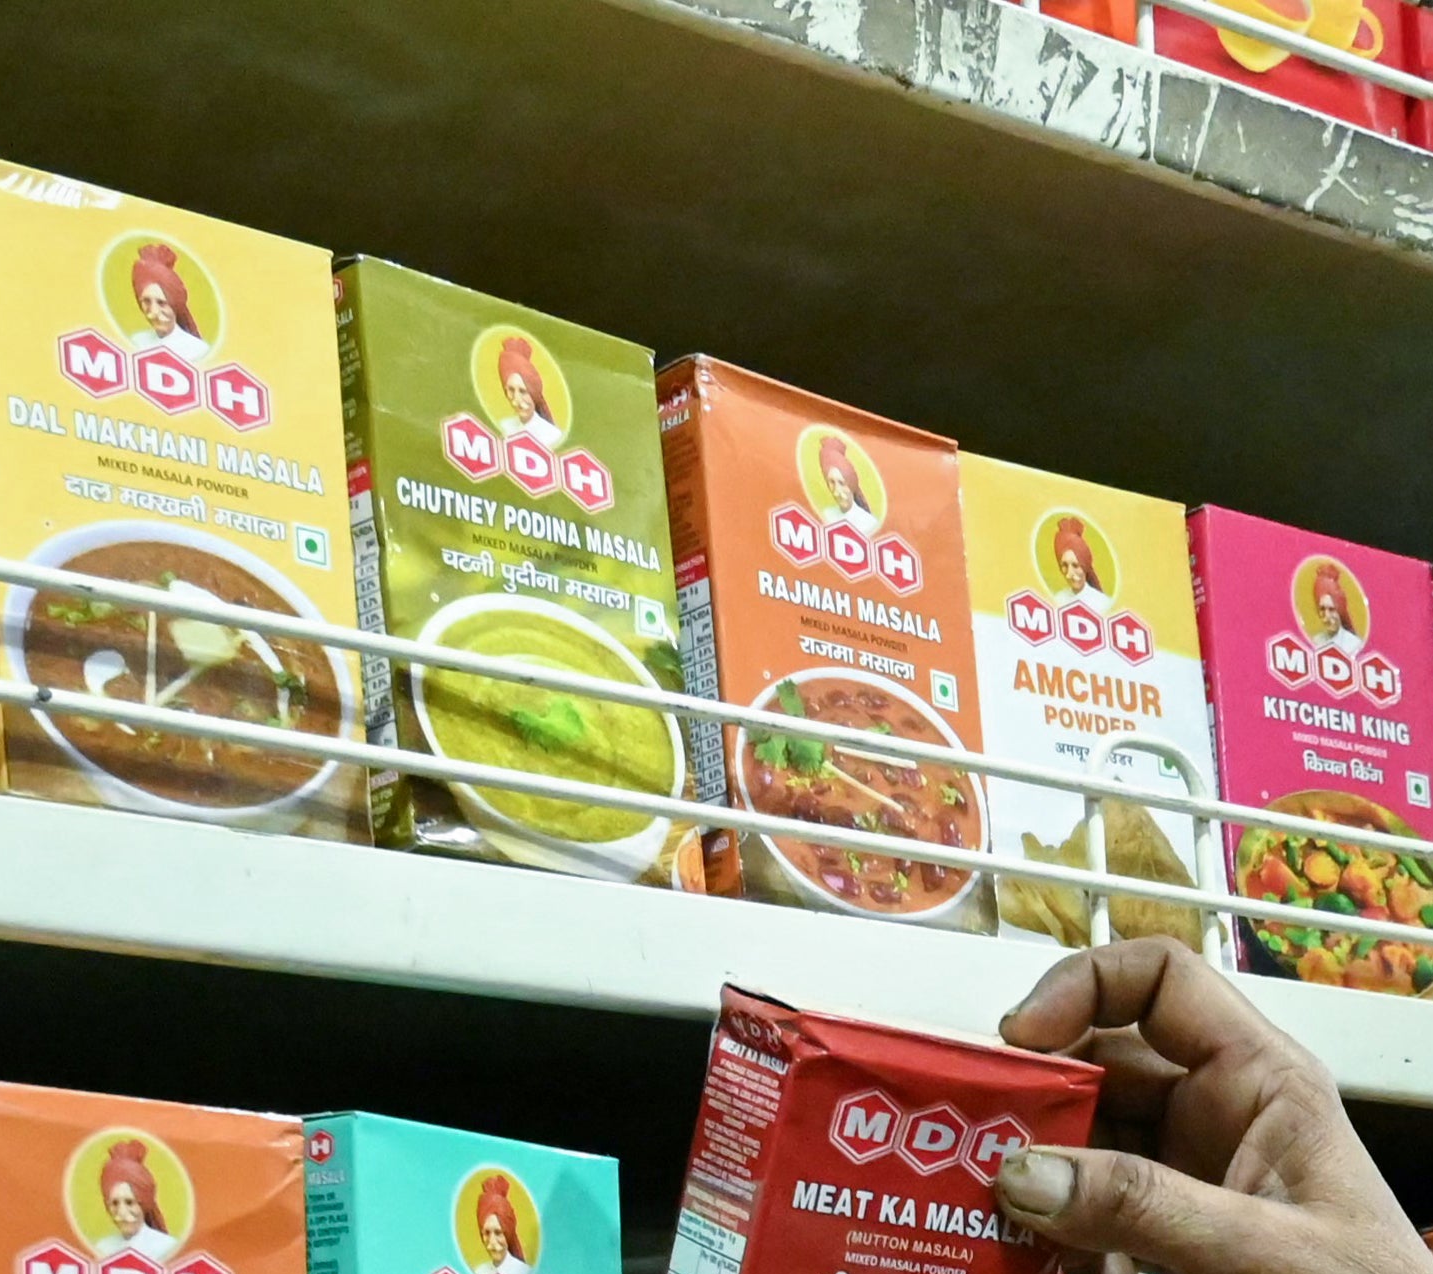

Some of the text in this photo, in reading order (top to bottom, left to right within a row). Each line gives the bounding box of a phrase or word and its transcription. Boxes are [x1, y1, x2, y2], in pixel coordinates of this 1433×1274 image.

[8, 395, 325, 496] DAL MAKHANI MASALA
[63, 473, 113, 503] दाल
[215, 506, 287, 542] मसाला
[97, 455, 249, 500] MIXED MASALA POWDER
[396, 476, 662, 574] CHUTNEY PODINA MASALA
[758, 569, 942, 644] RAJMAH MASALA
[1013, 659, 1162, 717] AMCHUR
[1263, 695, 1411, 747] KITCHEN KING
[792, 1179, 1036, 1249] MEAT KA MASALA
[843, 1251, 878, 1268] MIXED
[879, 1257, 922, 1274] MASALA
[845, 1229, 974, 1264] (MUTTON MASALA)
